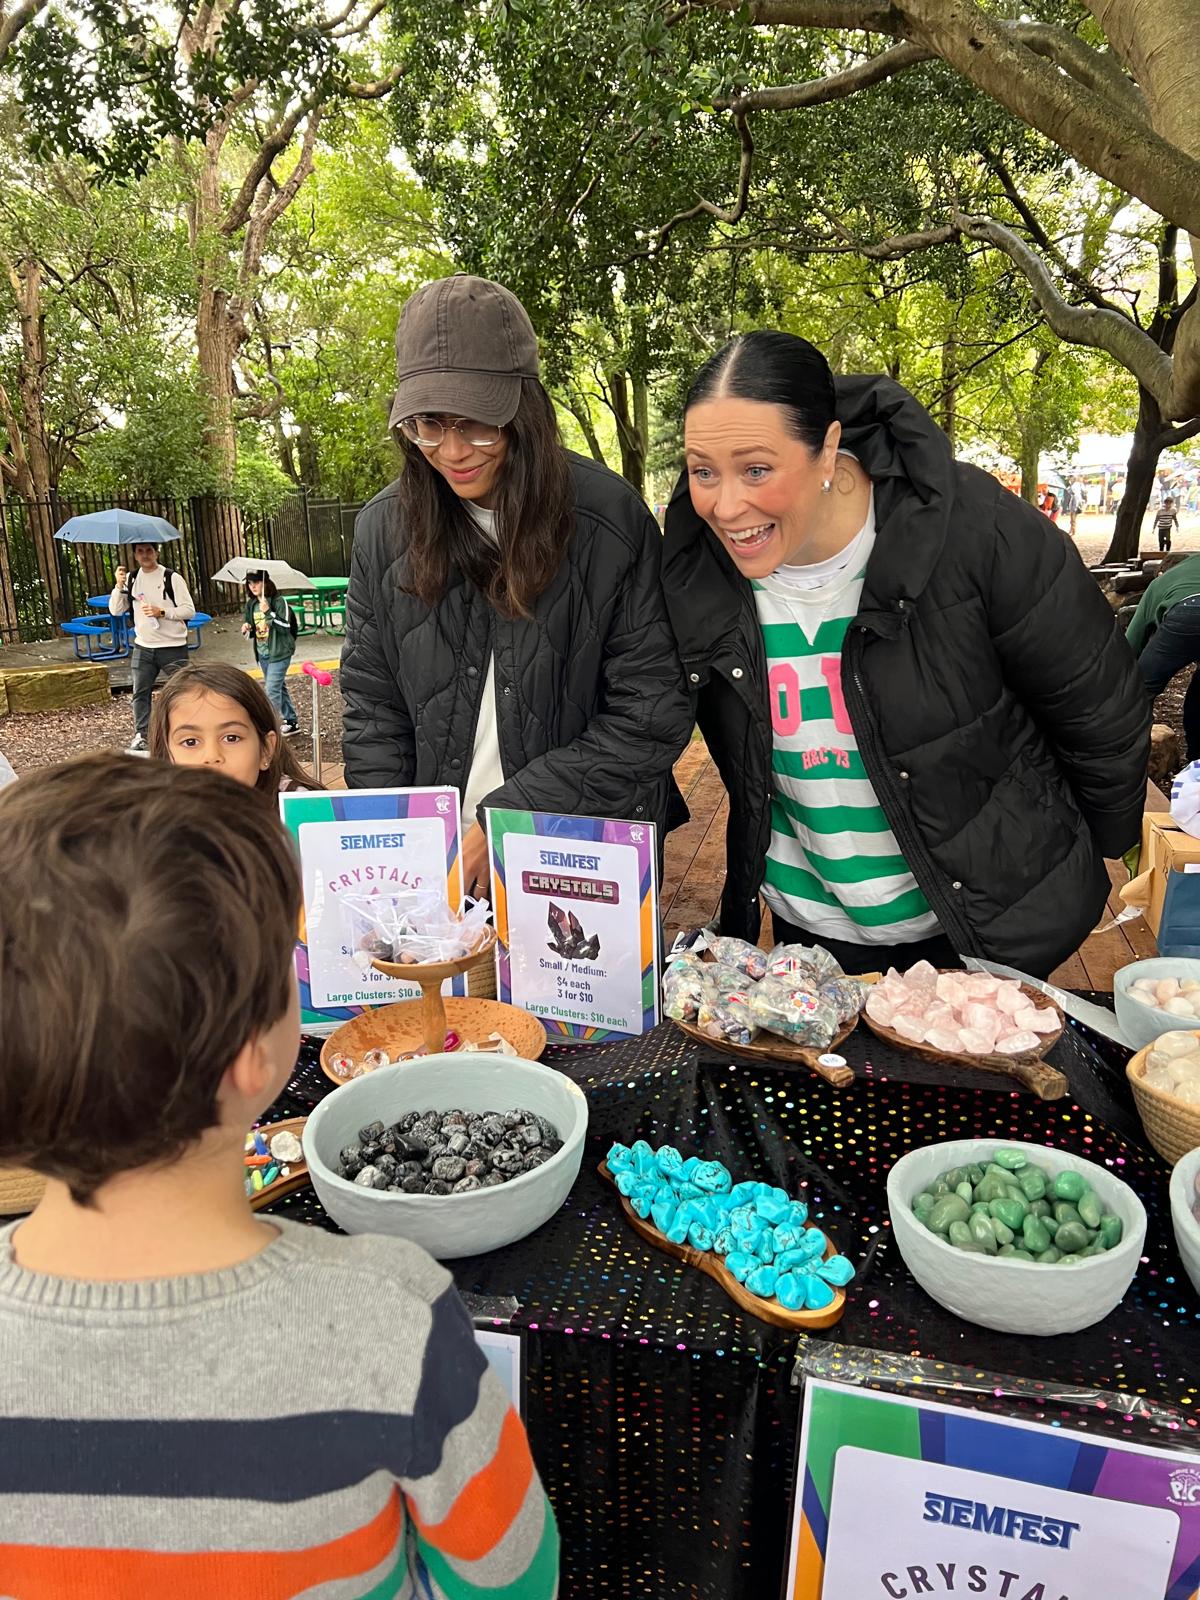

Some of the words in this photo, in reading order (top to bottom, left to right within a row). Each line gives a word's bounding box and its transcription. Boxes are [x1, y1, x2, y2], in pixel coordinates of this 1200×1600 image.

[801, 746, 829, 770] H&C
[340, 833, 405, 850] STEMFEST
[539, 850, 601, 871] STEMFEST
[328, 865, 422, 892] CRYSTALS
[528, 875, 614, 899] CRYSTALS
[361, 972, 368, 982] 3
[370, 972, 383, 982] for
[539, 958, 563, 971] Small
[571, 963, 608, 978] Medium:
[556, 976, 569, 987] $4
[570, 980, 591, 991] each
[326, 992, 353, 1003] Large
[355, 989, 396, 1000] Clusters:
[398, 988, 413, 998] $10
[557, 988, 563, 998] 3
[565, 990, 578, 1000] for
[579, 991, 594, 1003] $10
[525, 1002, 549, 1015] Large
[550, 1005, 589, 1021] Clusters:
[590, 1011, 605, 1024] $10
[606, 1018, 628, 1028] each
[922, 1491, 1081, 1549] STEMFEST
[880, 1563, 1069, 1600] CRYSTA
